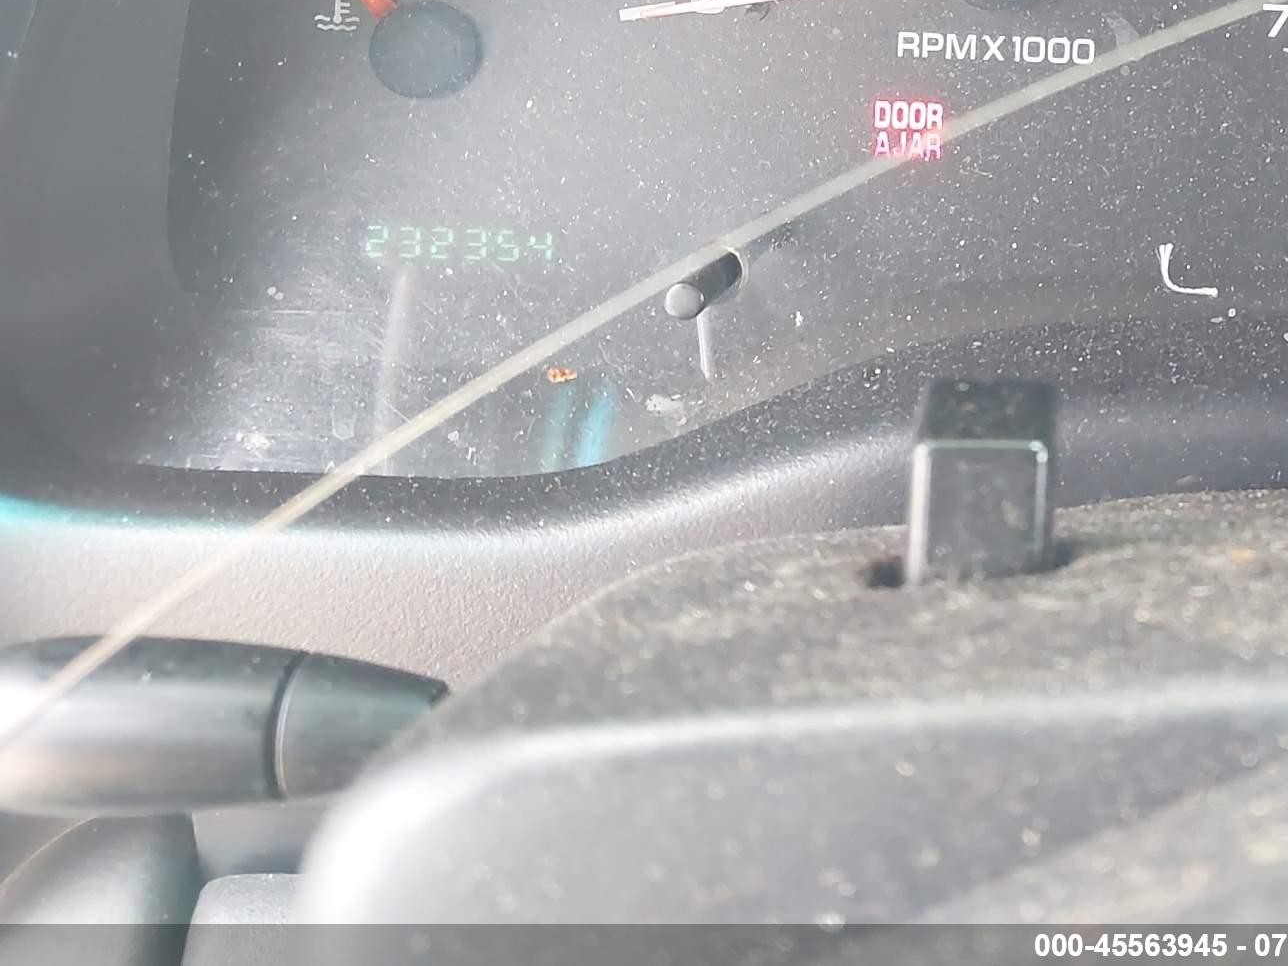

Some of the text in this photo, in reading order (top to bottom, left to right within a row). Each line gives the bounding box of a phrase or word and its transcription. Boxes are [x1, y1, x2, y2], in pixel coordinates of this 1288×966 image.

[896, 32, 978, 60] RPM
[1011, 36, 1095, 64] 1000
[874, 100, 943, 129] DOOR
[874, 131, 943, 160] AJAR
[366, 226, 552, 262] 232354
